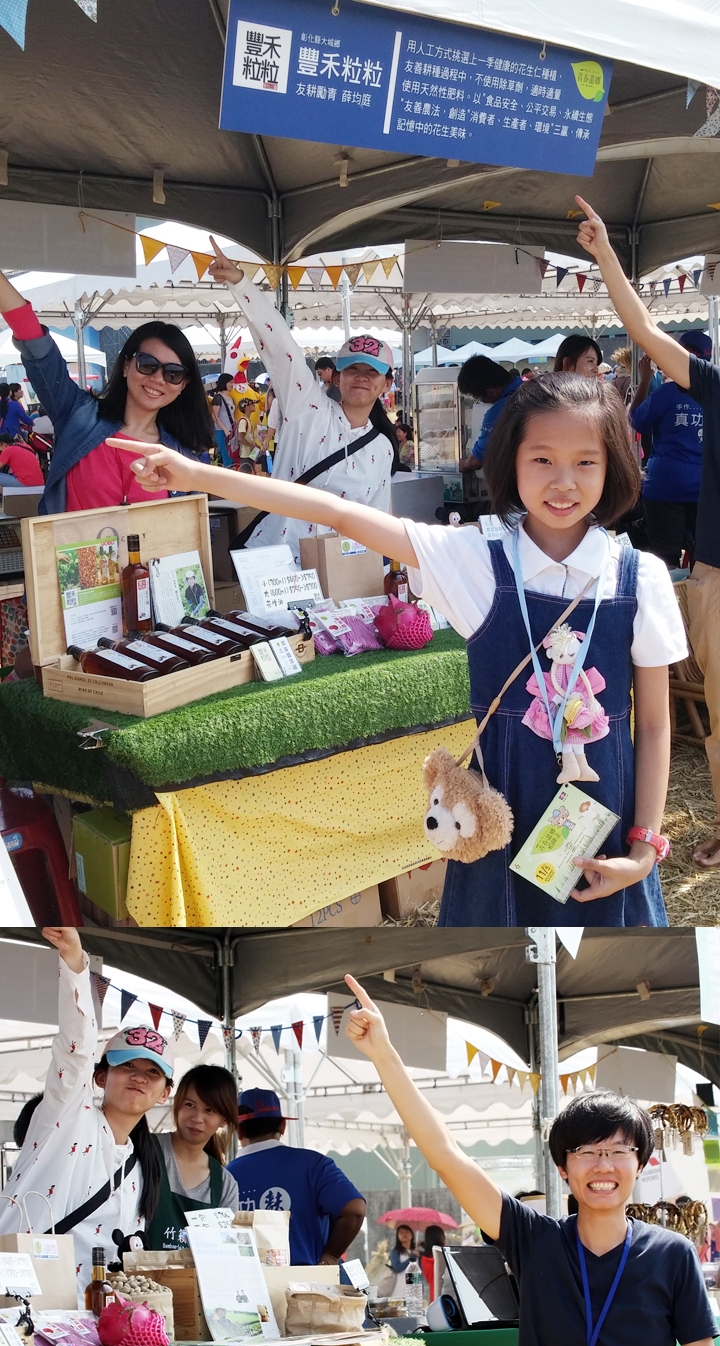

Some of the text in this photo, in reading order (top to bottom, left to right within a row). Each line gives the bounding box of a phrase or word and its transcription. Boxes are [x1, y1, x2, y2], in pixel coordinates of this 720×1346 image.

[244, 30, 282, 59] 豐禾
[242, 56, 280, 84] 粒粒
[297, 46, 383, 88] 豐禾粒粒
[349, 335, 380, 357] 32
[674, 413, 703, 427] 真功
[126, 1027, 165, 1056] 32
